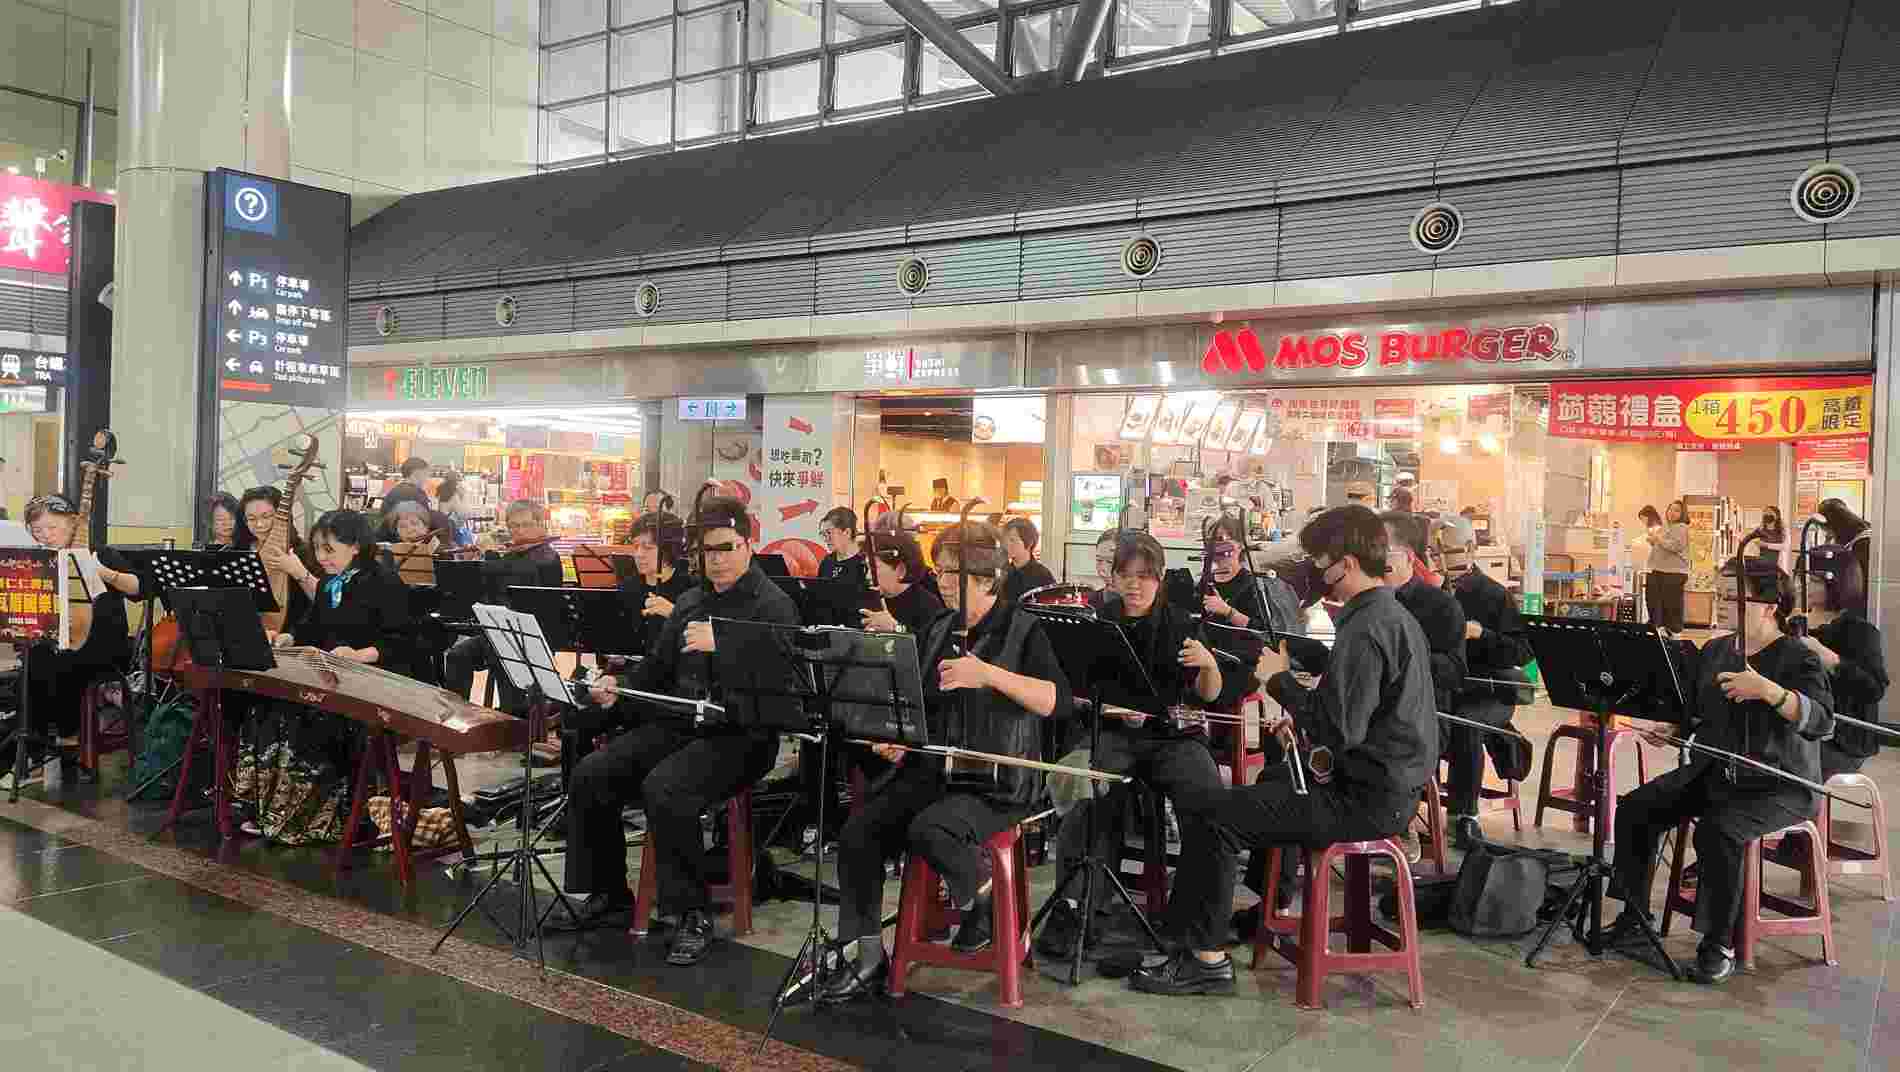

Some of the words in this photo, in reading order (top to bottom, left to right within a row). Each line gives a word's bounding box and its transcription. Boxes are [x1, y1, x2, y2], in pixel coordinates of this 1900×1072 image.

[1274, 334, 1369, 370] MOS
[1378, 323, 1561, 367] BURGER
[1557, 392, 1682, 427] 蒟蒻禮盒
[1714, 396, 1807, 435] 450
